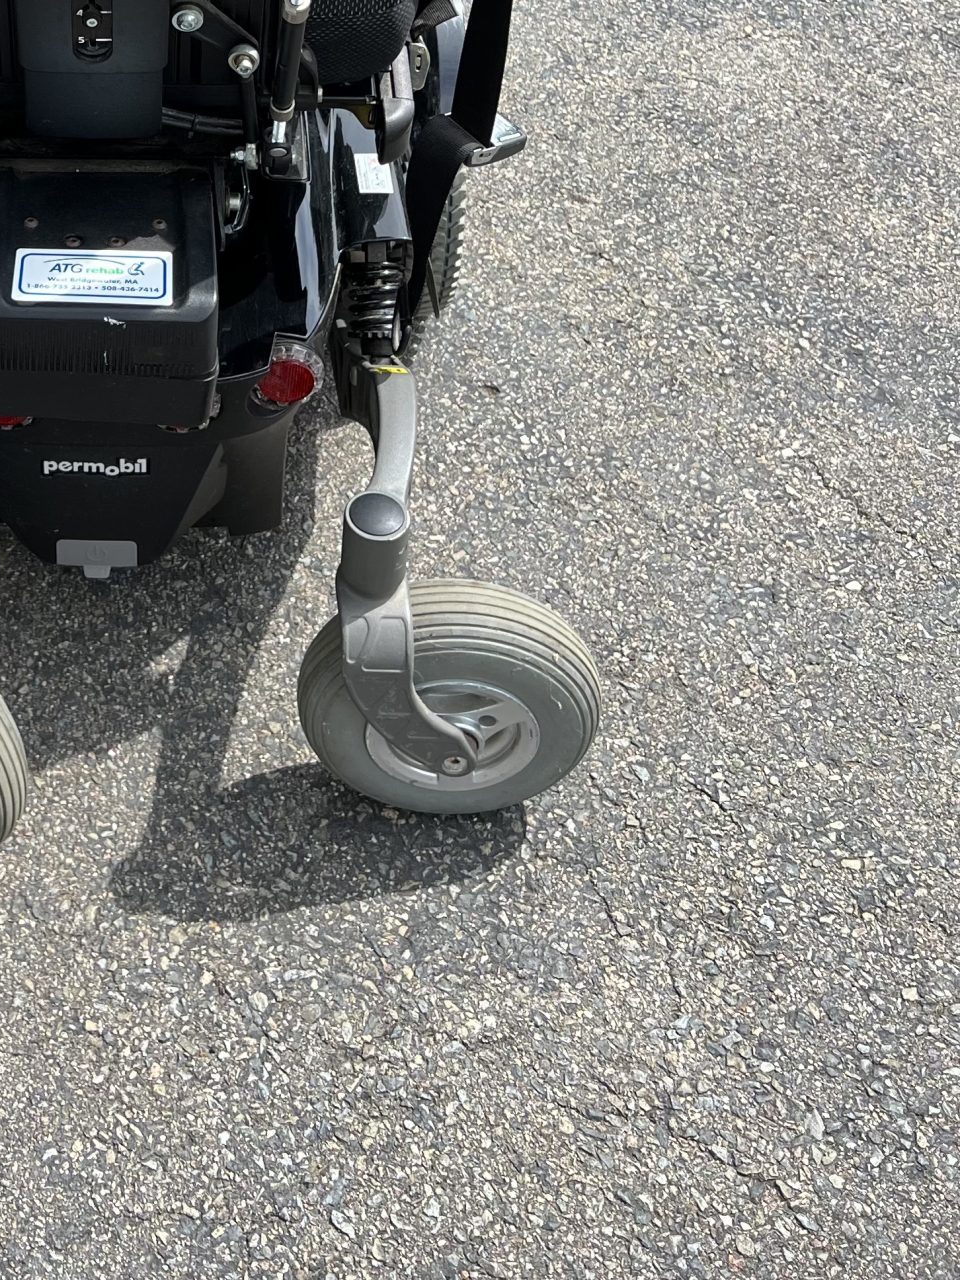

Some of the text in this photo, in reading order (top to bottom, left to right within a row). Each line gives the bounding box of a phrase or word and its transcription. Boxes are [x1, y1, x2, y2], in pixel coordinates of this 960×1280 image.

[76, 9, 83, 17] 4
[78, 36, 85, 44] 5
[49, 263, 124, 275] ATG rehab
[43, 458, 147, 476] permobil
